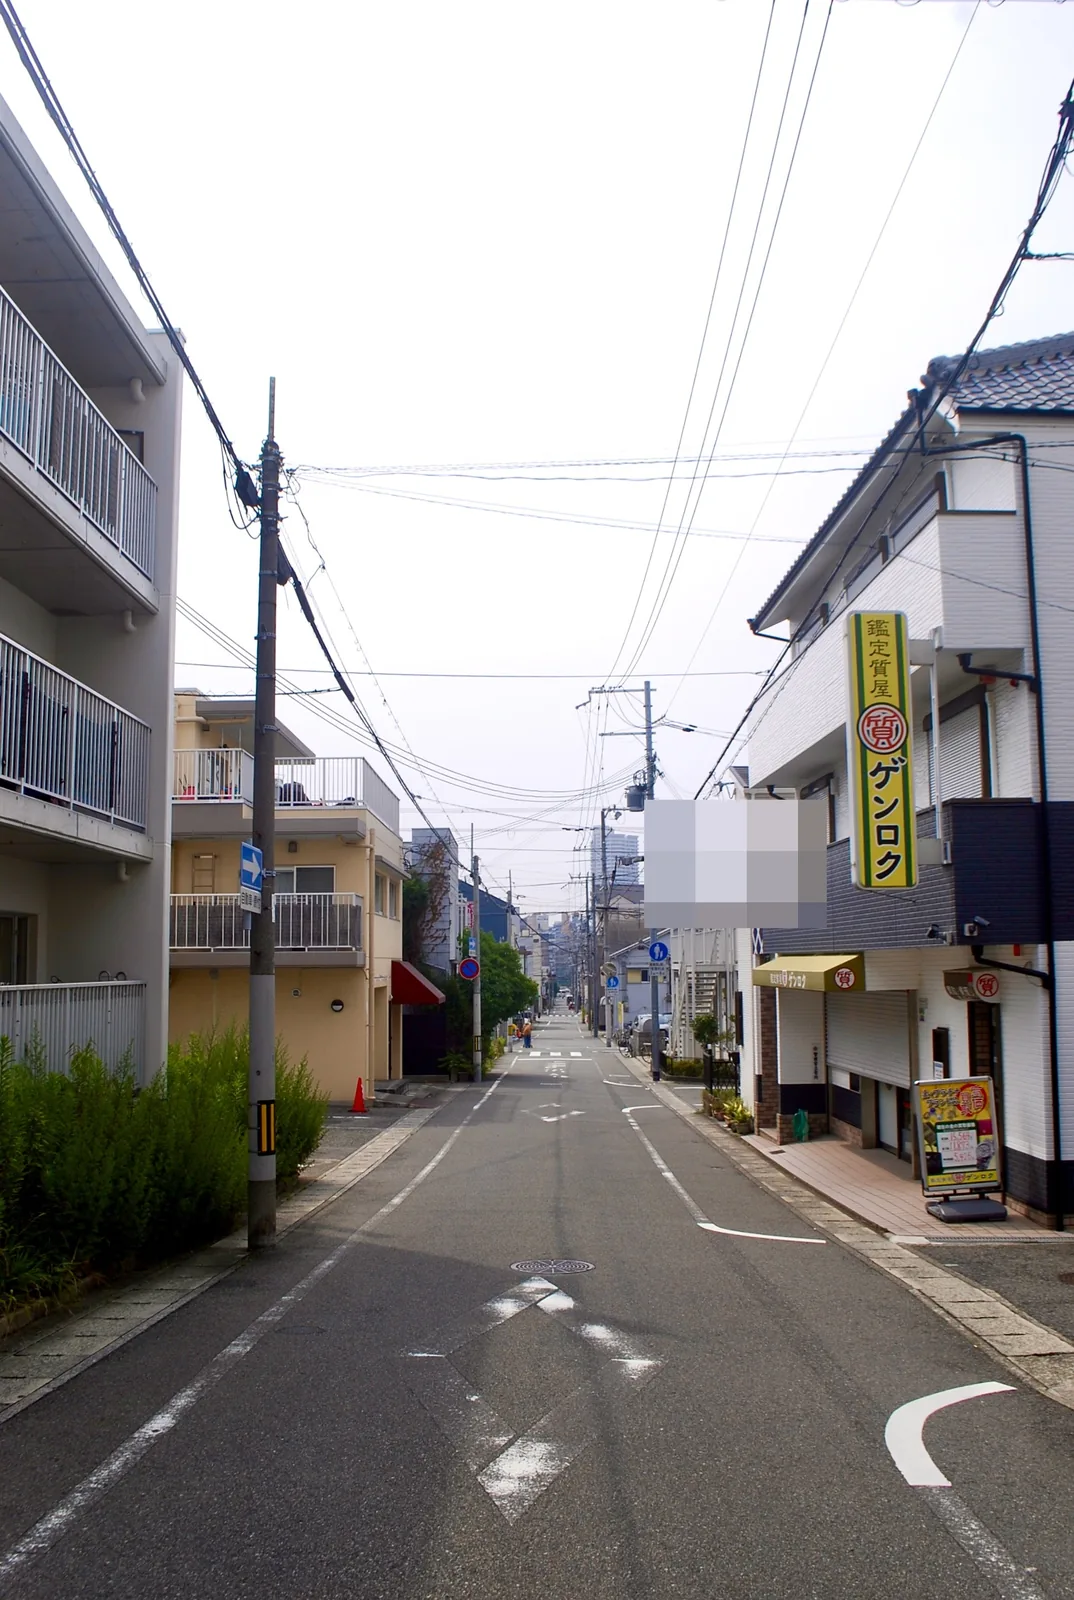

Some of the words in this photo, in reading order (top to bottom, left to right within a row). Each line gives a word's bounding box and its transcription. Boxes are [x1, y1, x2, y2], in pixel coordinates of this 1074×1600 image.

[866, 619, 893, 698] 鑑定質屋
[863, 711, 901, 750] 質
[868, 755, 907, 881] ゲンロク
[836, 970, 853, 988] 質
[978, 976, 997, 996] 質
